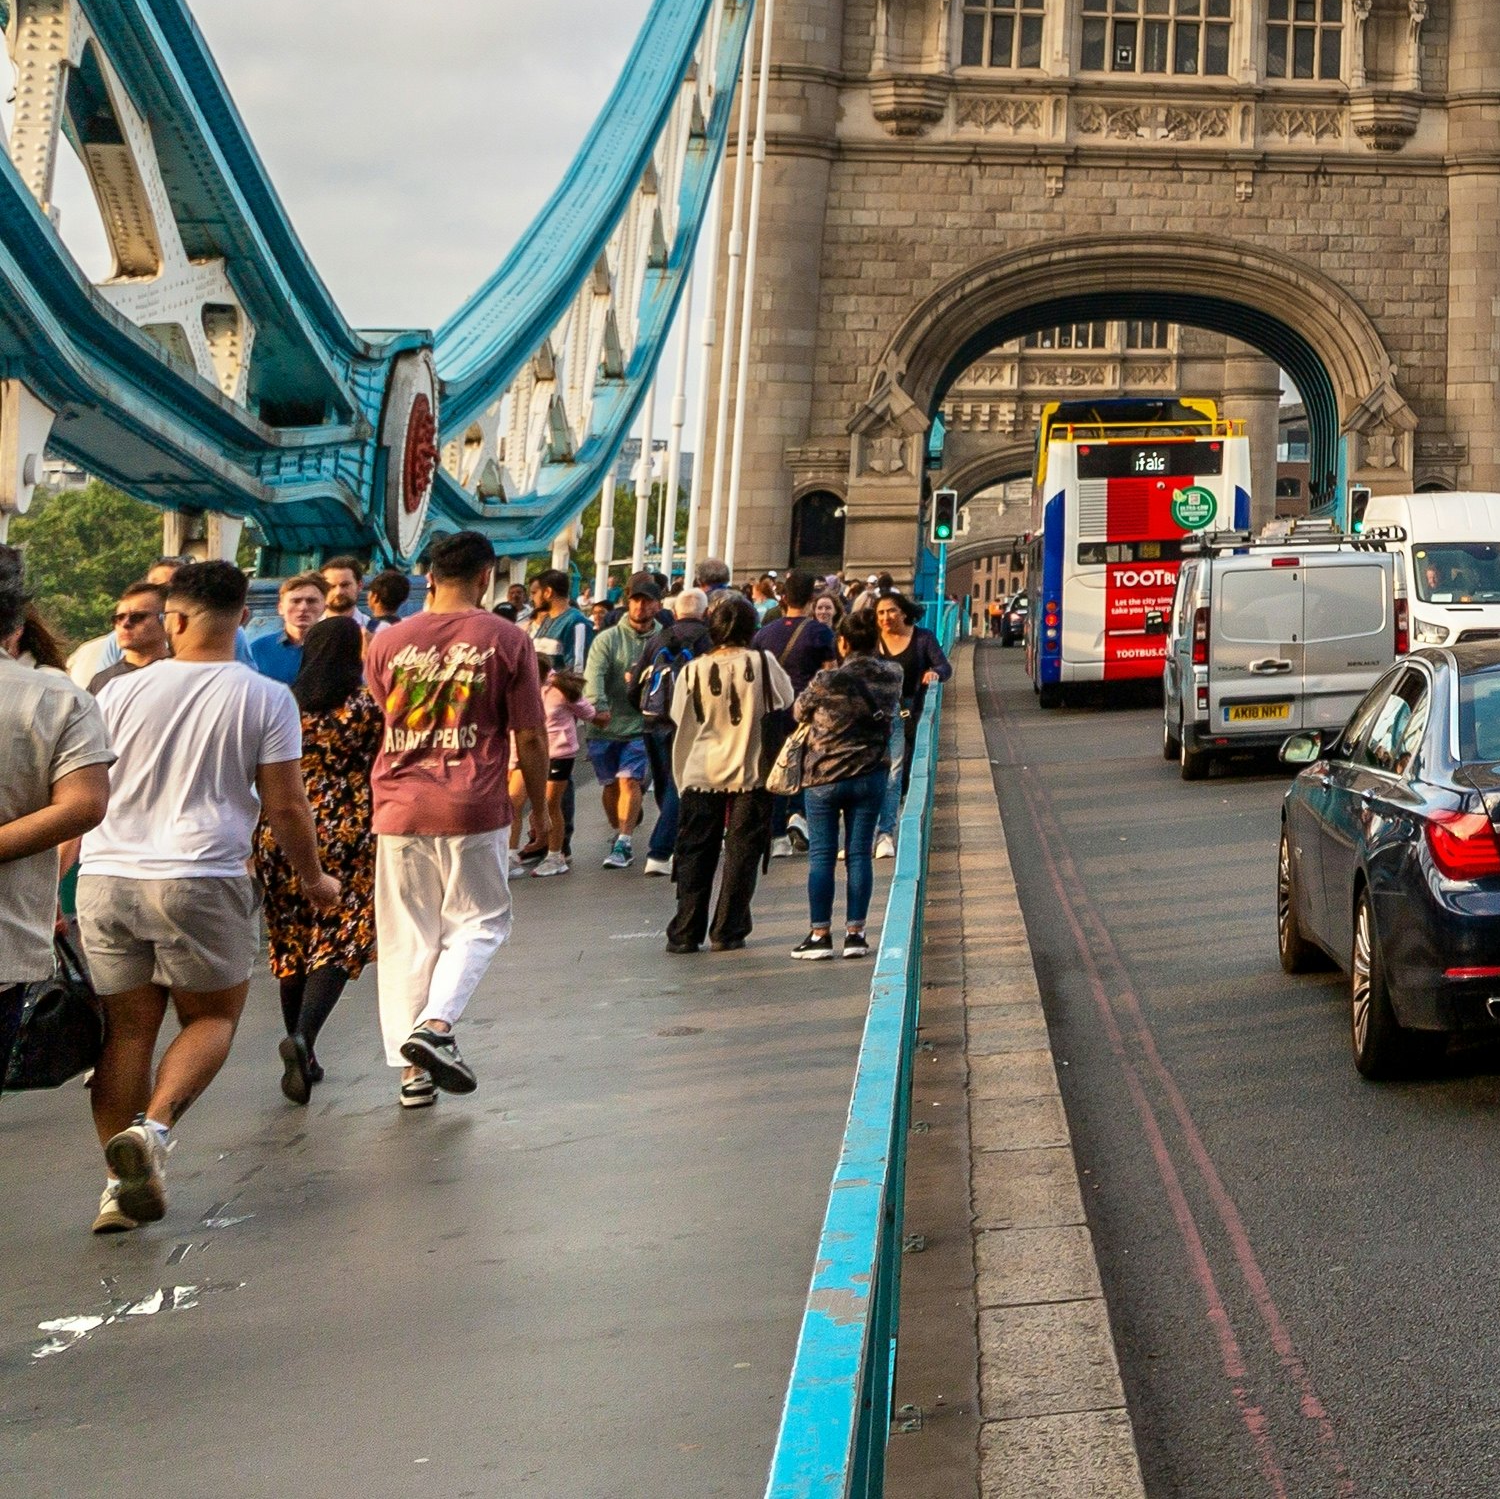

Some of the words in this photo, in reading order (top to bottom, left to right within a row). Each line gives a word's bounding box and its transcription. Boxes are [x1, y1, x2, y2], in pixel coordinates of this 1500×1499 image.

[1115, 599, 1127, 607] Let
[1128, 597, 1141, 606] the
[1142, 598, 1156, 607] city
[1111, 606, 1128, 615] take
[1129, 607, 1143, 615] you
[1116, 648, 1169, 658] TOOTBUS.CO
[385, 726, 430, 753] ABATE
[432, 723, 478, 749] PEARS
